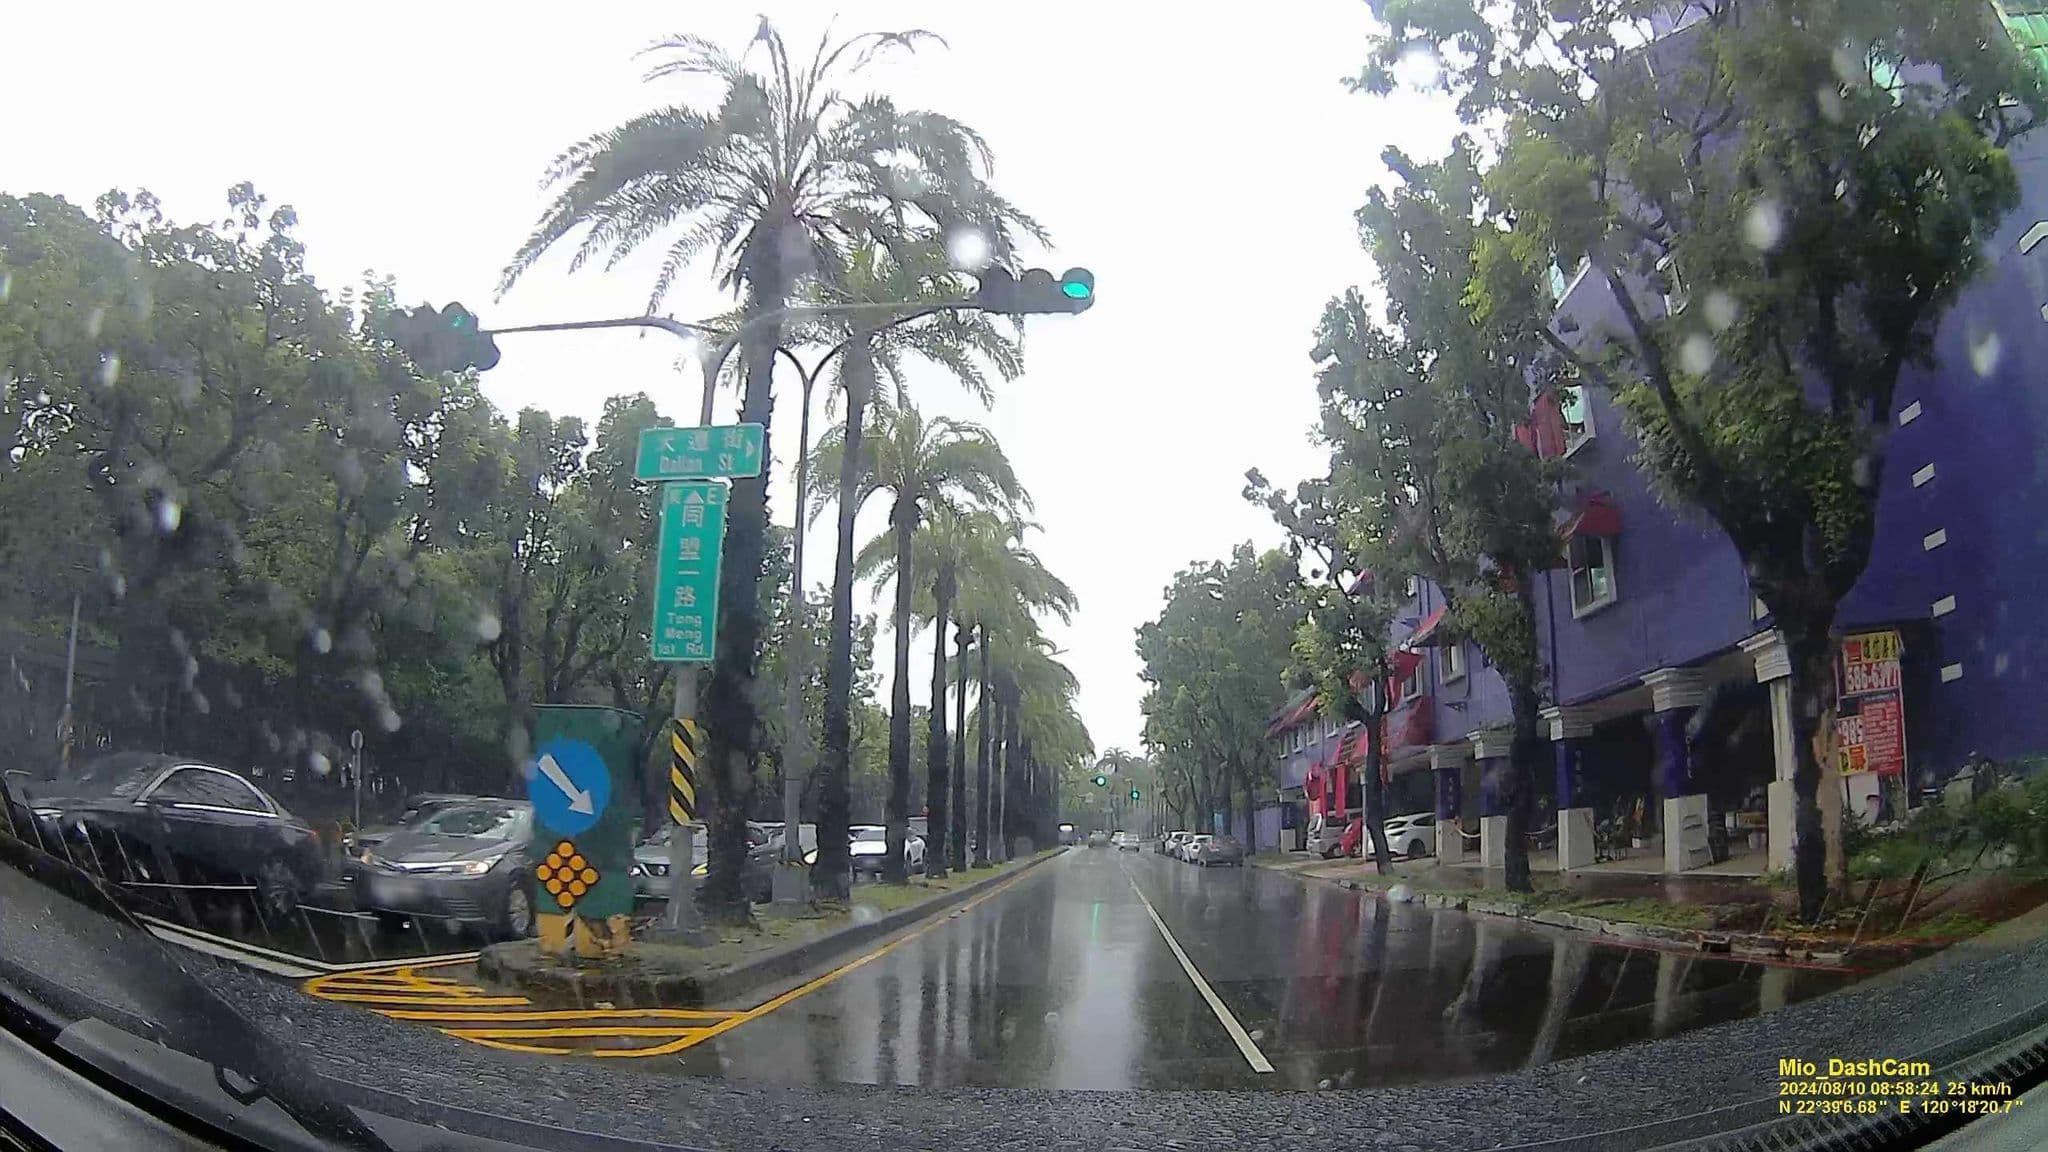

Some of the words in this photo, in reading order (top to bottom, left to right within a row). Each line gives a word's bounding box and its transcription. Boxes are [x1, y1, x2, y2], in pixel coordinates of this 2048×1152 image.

[666, 612, 702, 626] Tong
[665, 627, 702, 643] Meng
[686, 642, 704, 656] Rd
